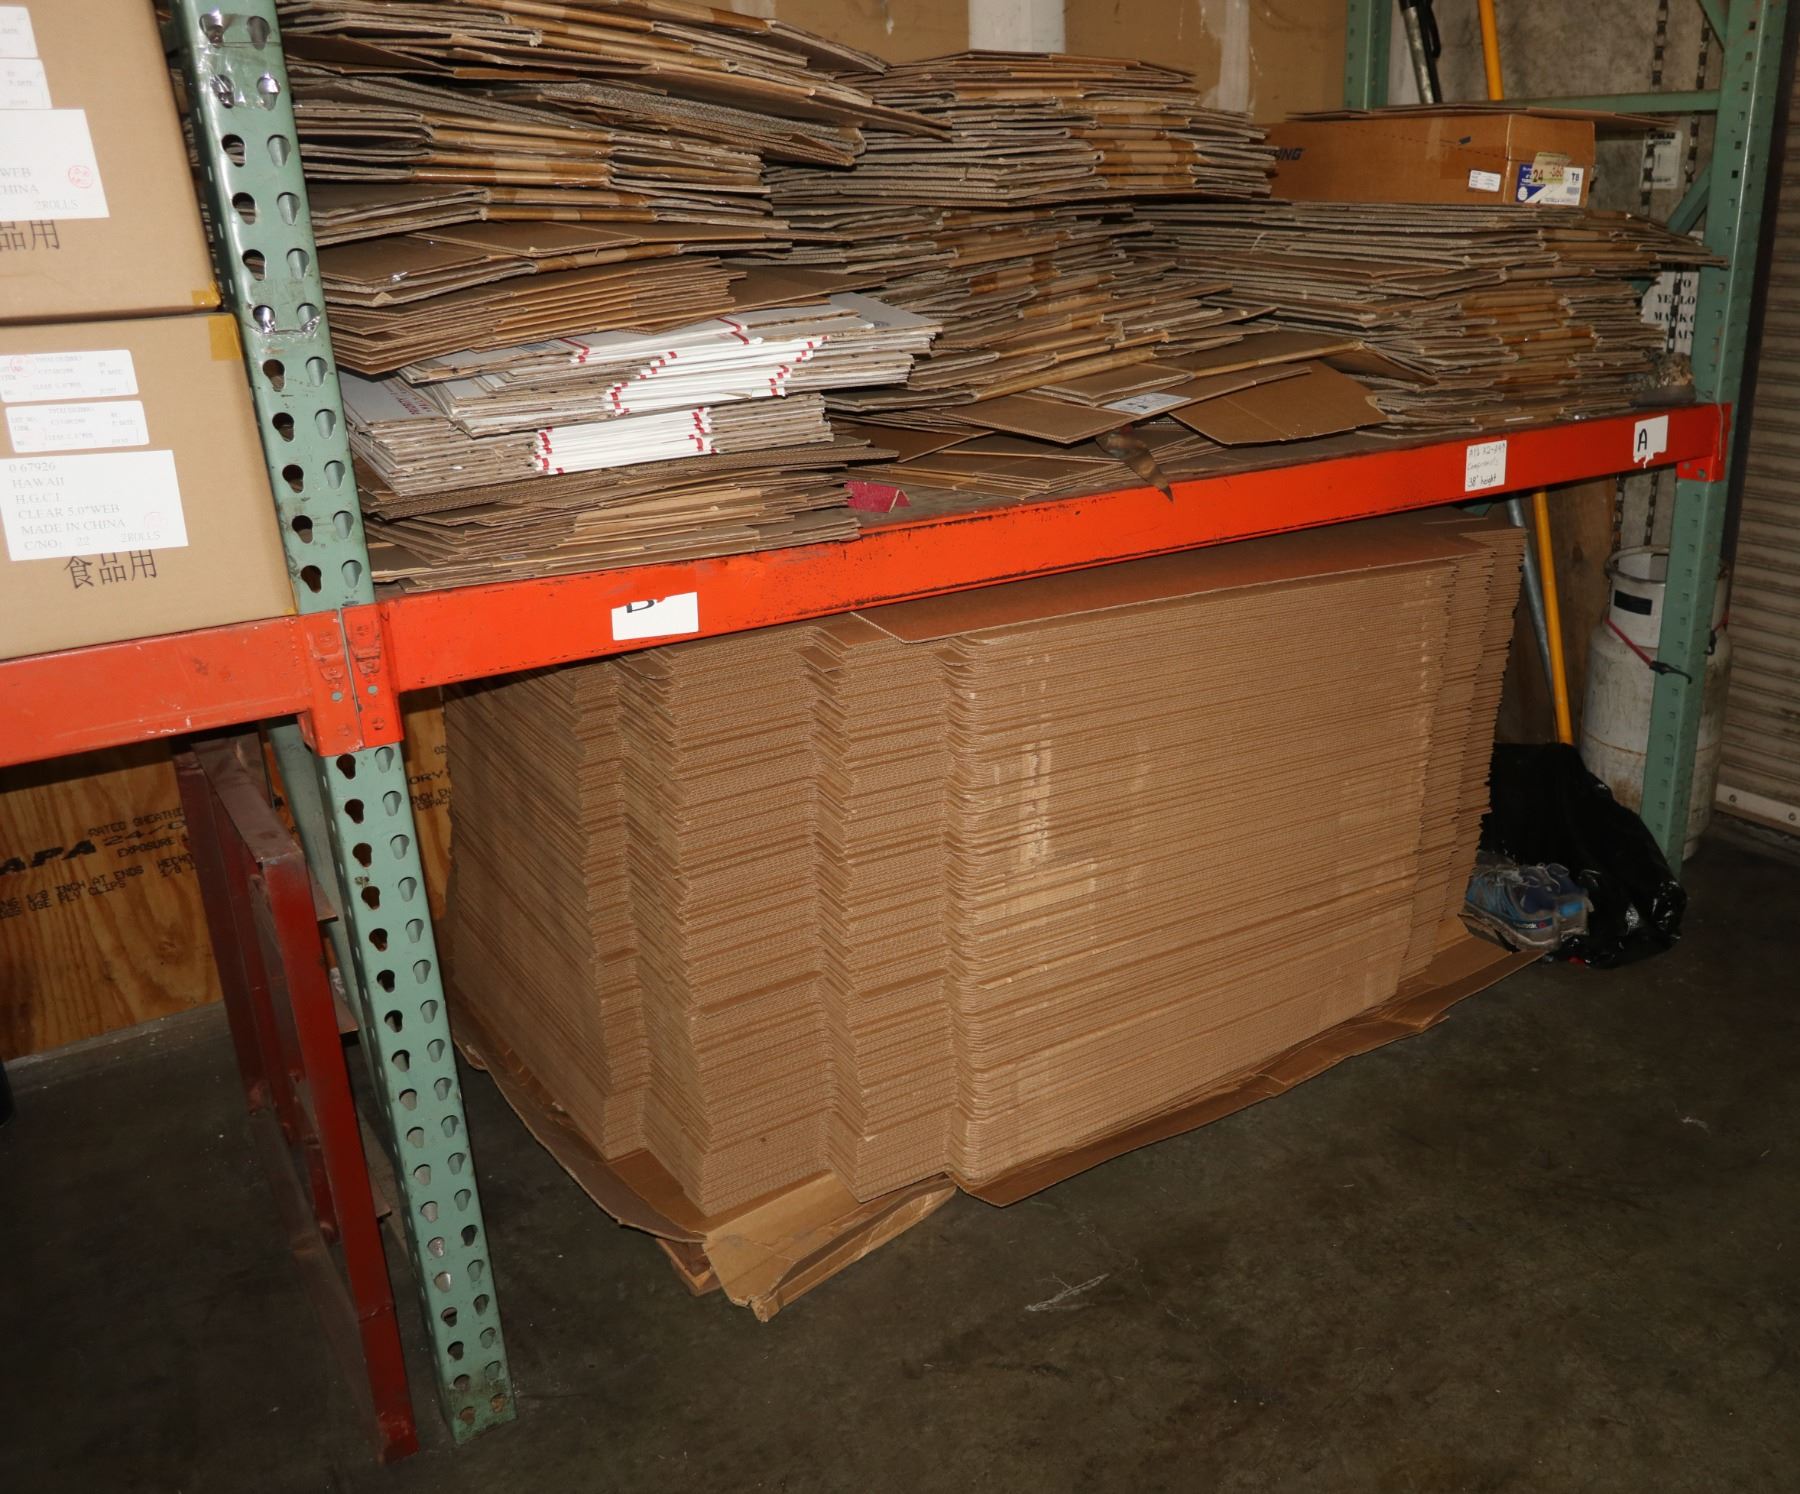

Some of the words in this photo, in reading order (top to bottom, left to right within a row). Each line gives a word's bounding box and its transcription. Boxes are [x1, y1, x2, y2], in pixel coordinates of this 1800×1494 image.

[1637, 428, 1648, 452] A
[18, 507, 64, 520] CLEAR
[21, 523, 63, 536] MADE
[66, 522, 80, 532] IN
[83, 519, 128, 530] CHINA
[63, 549, 159, 589] 食品用
[117, 837, 176, 858] EXPOSURE
